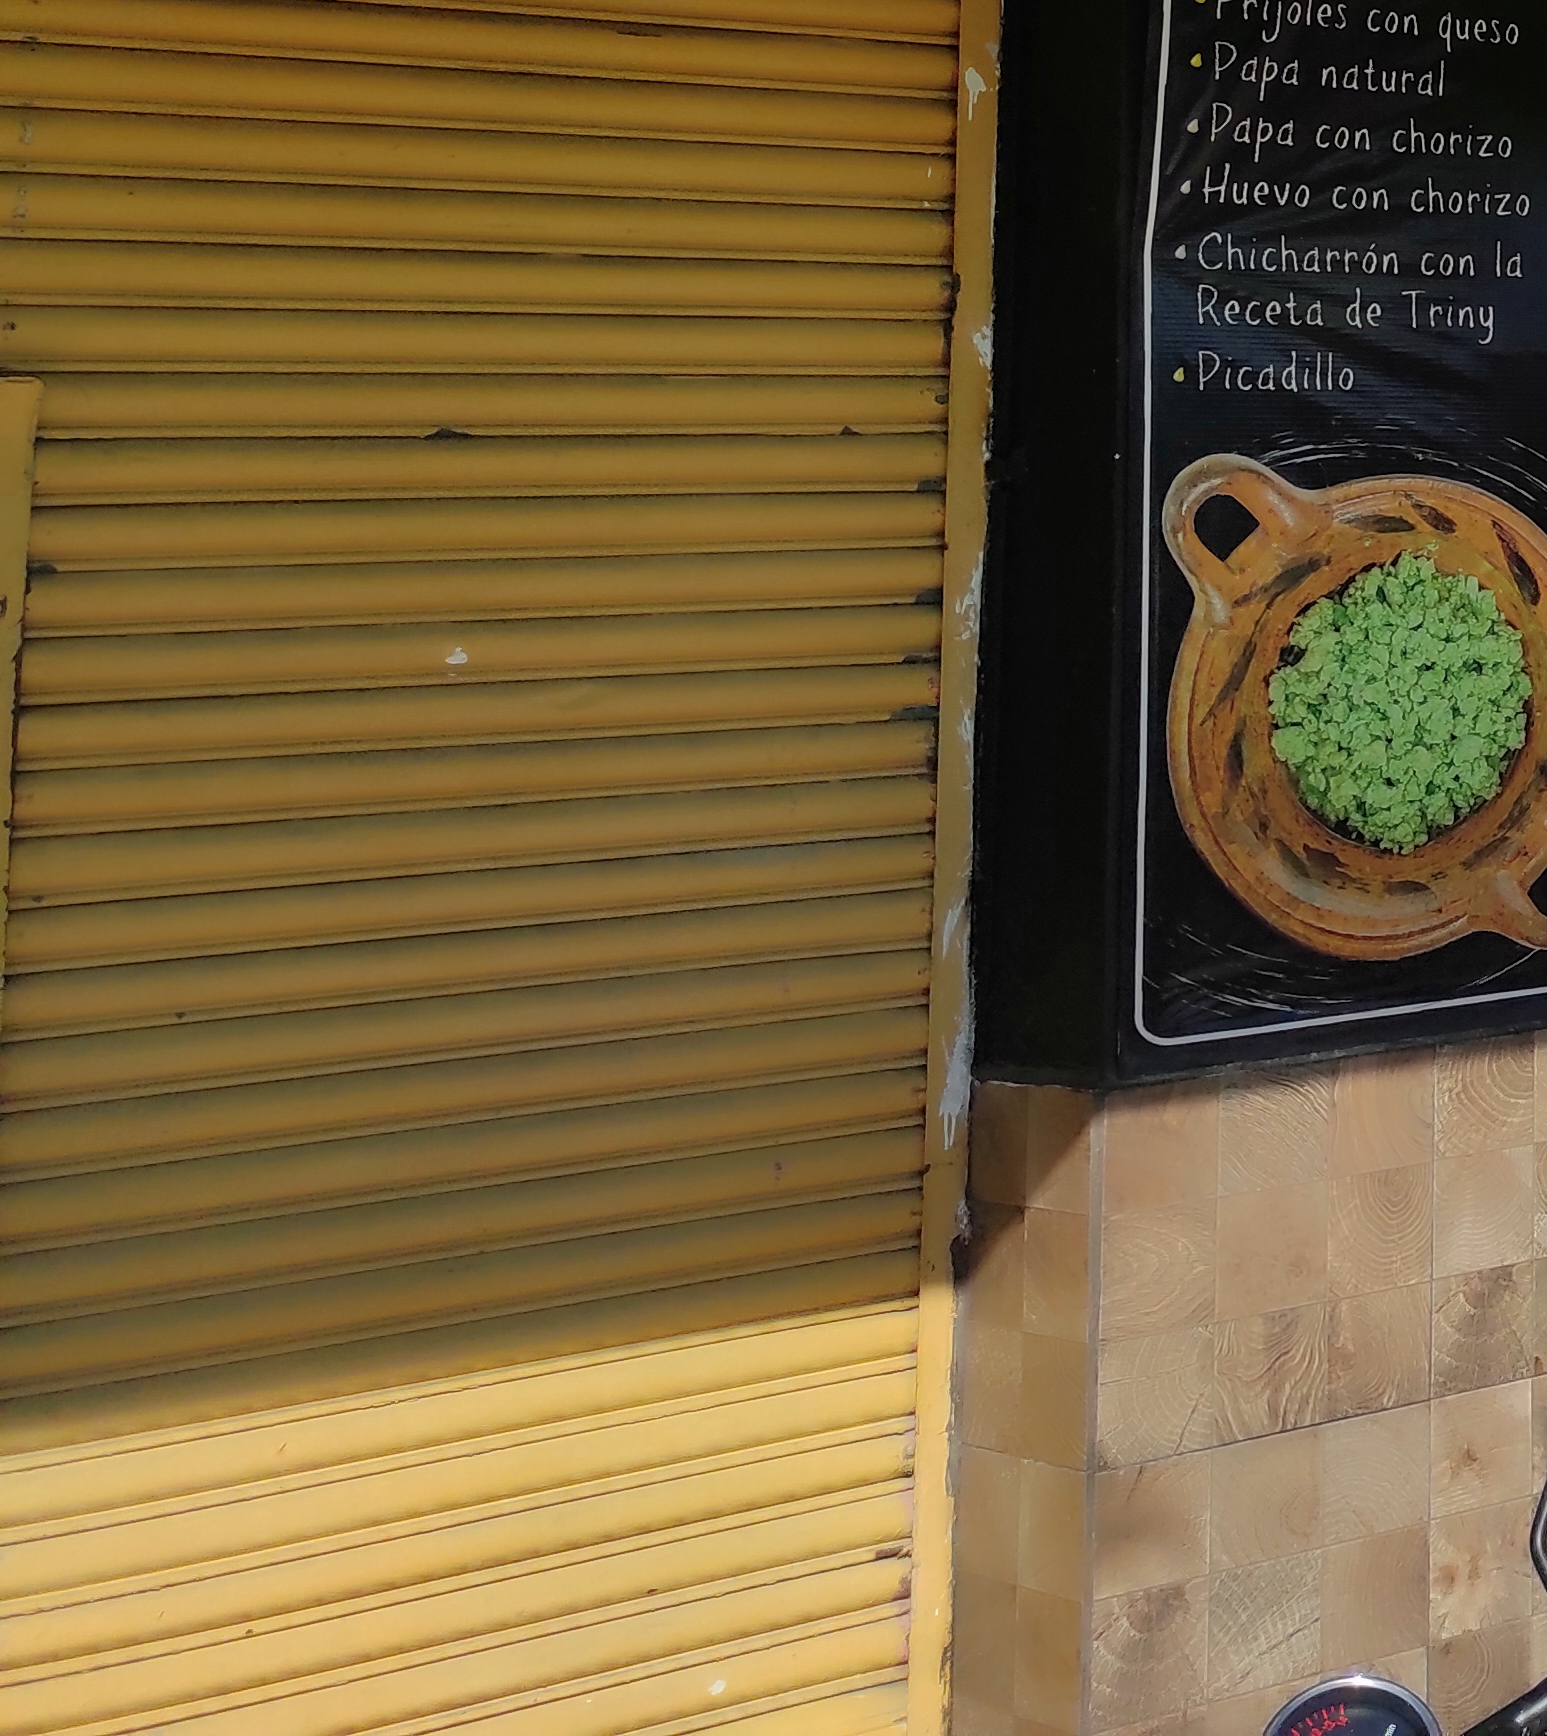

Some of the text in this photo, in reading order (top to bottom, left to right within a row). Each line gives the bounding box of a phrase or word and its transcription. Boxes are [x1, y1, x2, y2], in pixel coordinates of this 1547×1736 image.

[1366, 5, 1419, 37] con
[1438, 11, 1520, 53] queso
[1213, 40, 1446, 101] Papa natural
[1210, 102, 1513, 164] Papa con chorizo
[1202, 163, 1531, 218] Huevo con chorizo
[1197, 231, 1523, 279] Chicharrón con la
[1197, 283, 1495, 345] Receta de Triny
[1197, 350, 1355, 393] Picadillo
